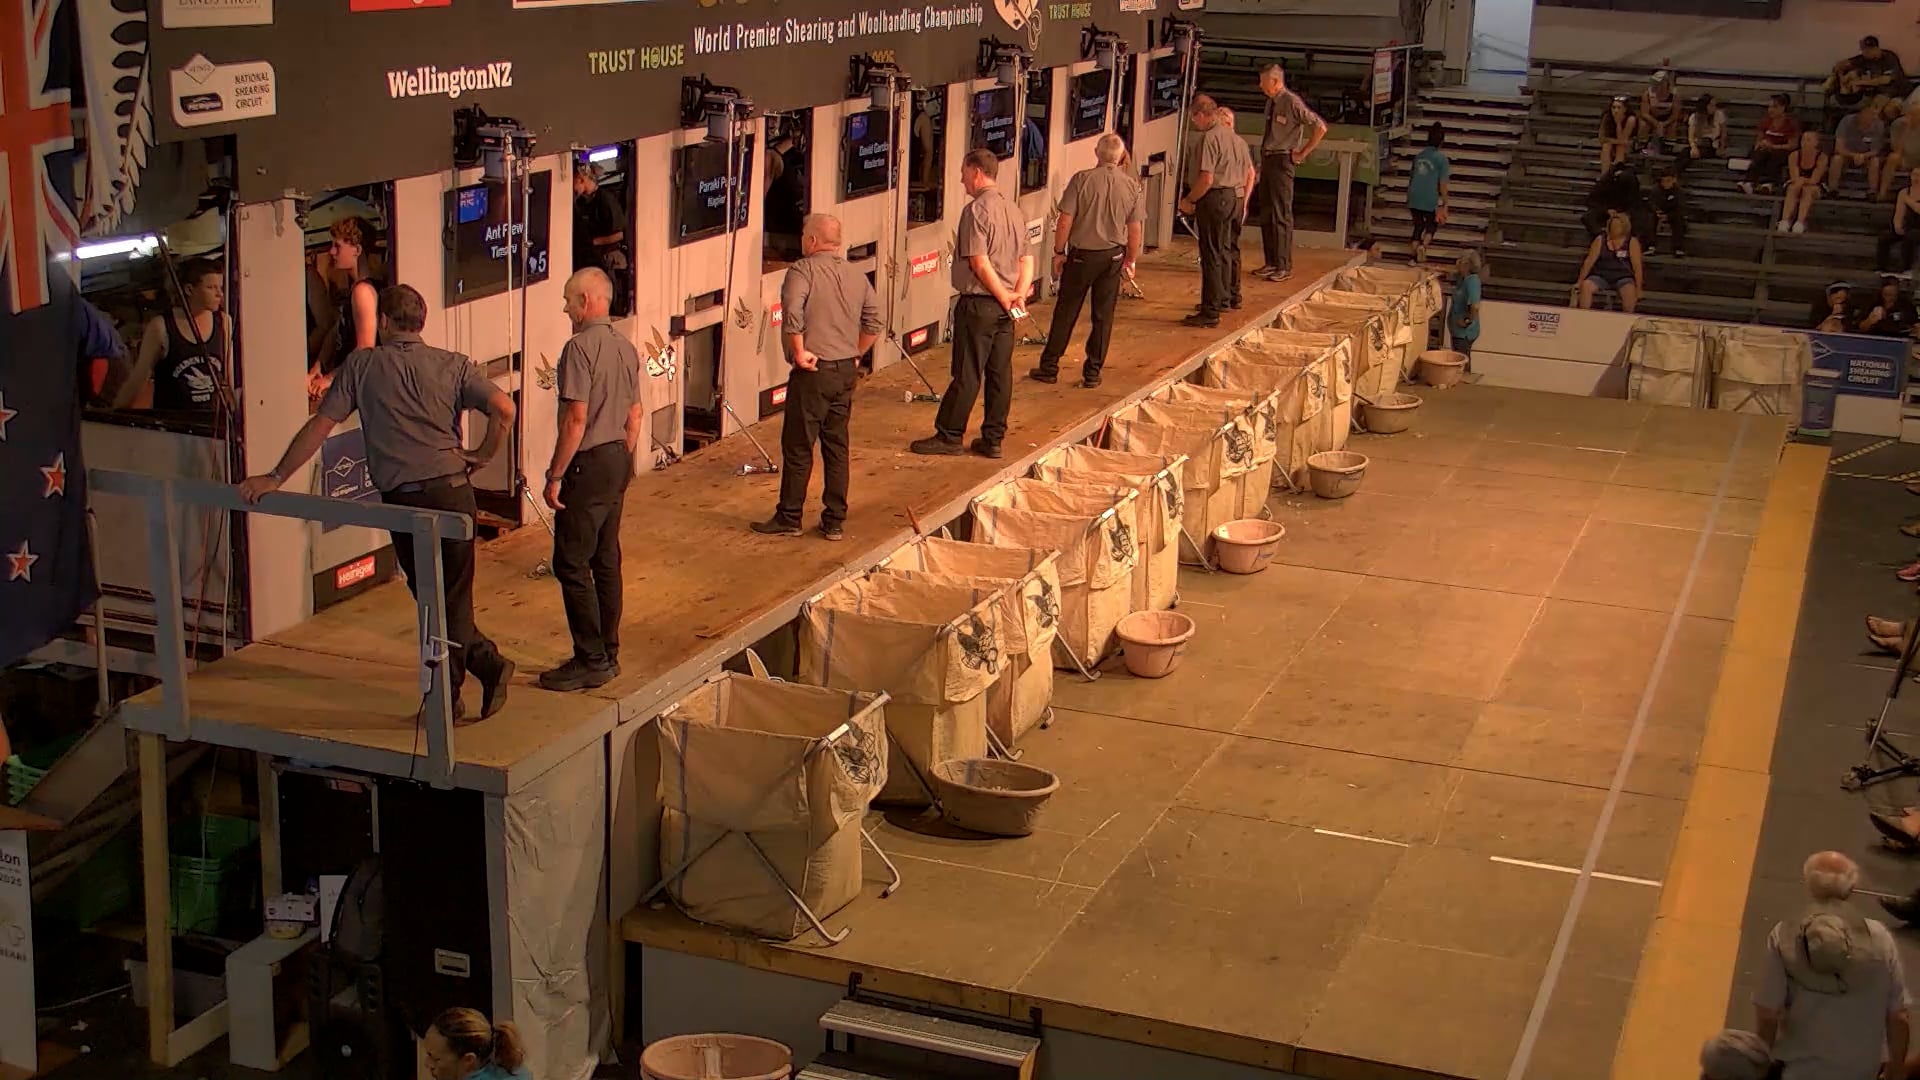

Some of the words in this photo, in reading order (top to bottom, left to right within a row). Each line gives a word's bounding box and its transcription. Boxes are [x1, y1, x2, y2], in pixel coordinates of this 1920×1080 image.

[1049, 4, 1069, 19] TRUST
[1071, 2, 1091, 18] HOUSE
[694, 24, 731, 54] World
[736, 21, 781, 50] Premier
[785, 17, 834, 44] Shearing
[837, 12, 856, 37] and
[858, 8, 921, 36] Woolhandling
[924, 2, 983, 31] Championship
[588, 48, 635, 75] TRUST
[640, 44, 685, 70] HOUSE
[235, 71, 270, 84] NATIONAL
[387, 62, 512, 98] WellingtonNZ
[235, 83, 270, 97] SHEARING
[236, 97, 263, 109] CIRCUIT
[740, 203, 748, 221] 5
[485, 223, 501, 242] Ant
[502, 222, 524, 238] Few
[681, 224, 687, 237] 2
[537, 251, 547, 273] 5
[457, 279, 463, 294] 1
[1528, 311, 1560, 323] NOTICE
[1849, 359, 1891, 370] NATIONAL
[1848, 367, 1891, 378] SHEARING
[1847, 375, 1879, 385] CIRCUIT
